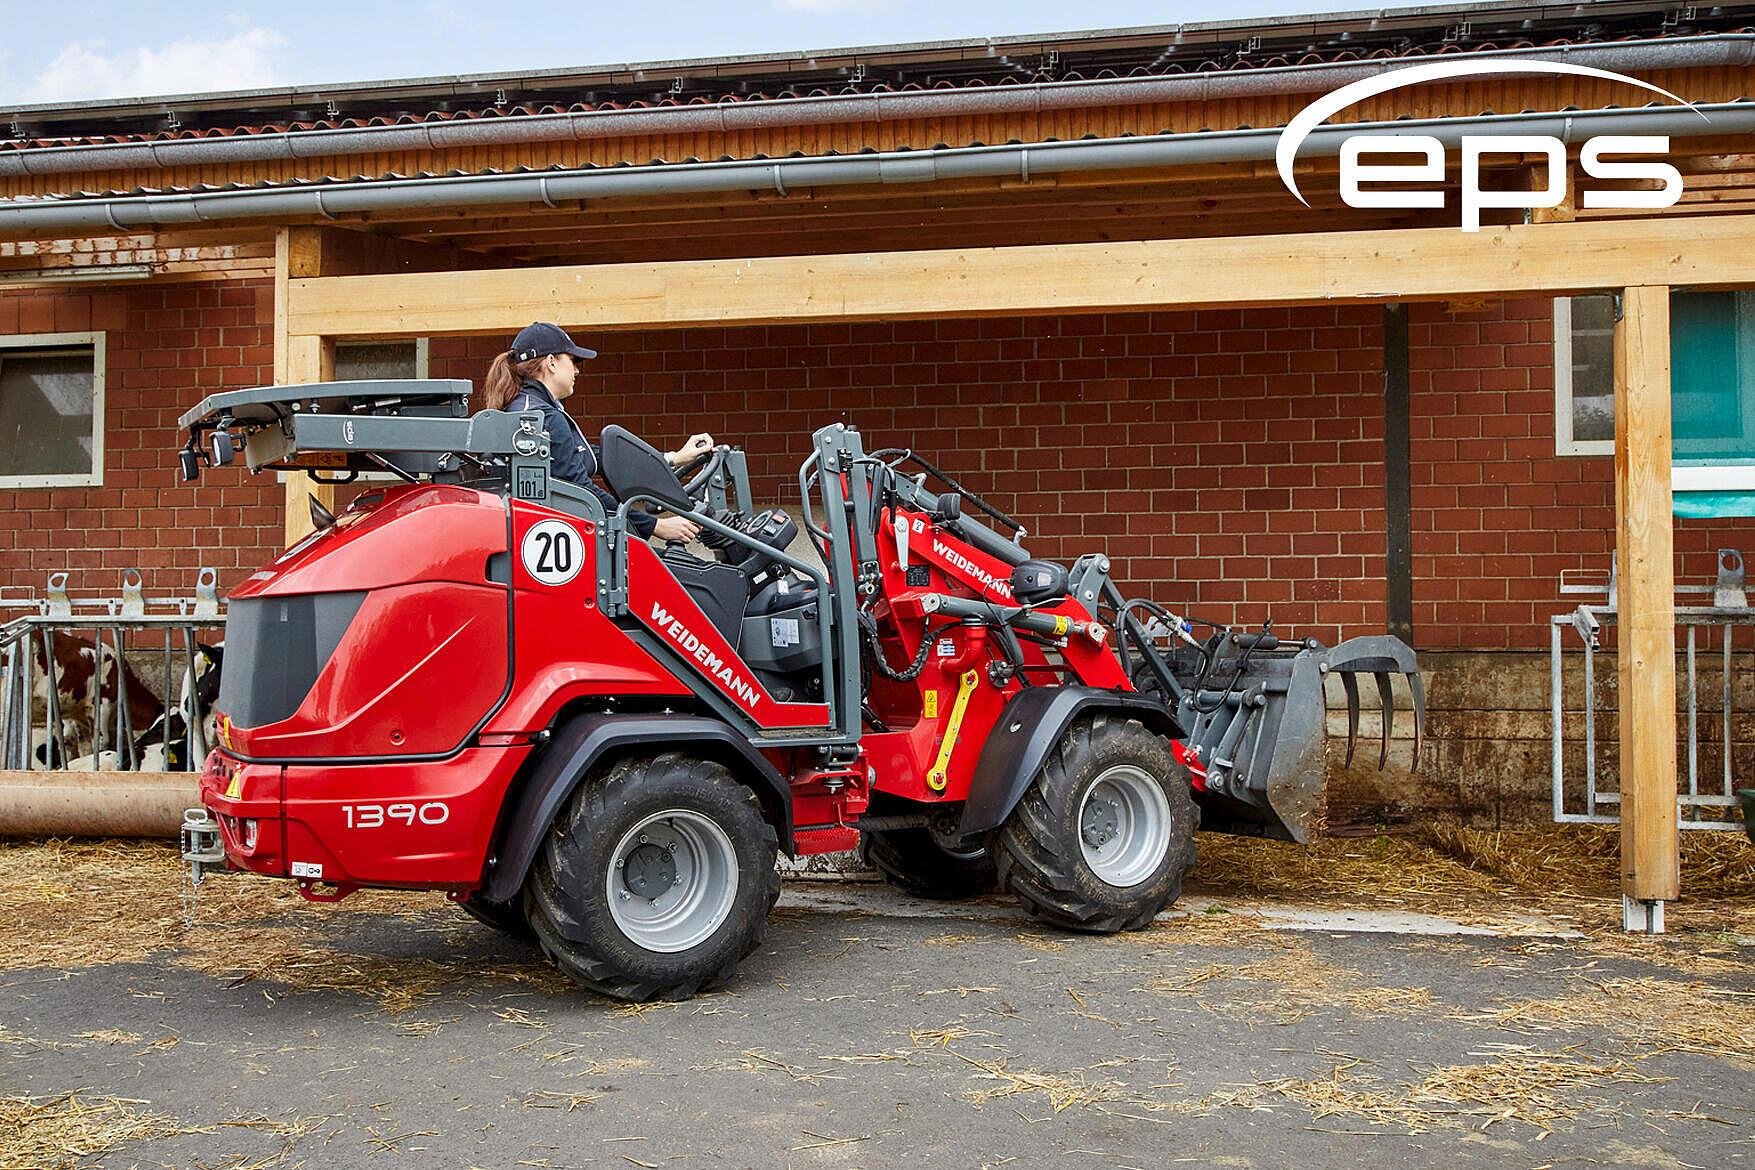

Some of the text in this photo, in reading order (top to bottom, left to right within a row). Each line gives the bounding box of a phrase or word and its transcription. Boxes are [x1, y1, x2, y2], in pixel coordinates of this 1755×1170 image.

[520, 480, 537, 497] 101
[535, 531, 572, 573] 20
[933, 538, 1012, 599] WEIDEMANN
[651, 601, 761, 708] WEIDEMANN
[342, 802, 450, 829] 1390
